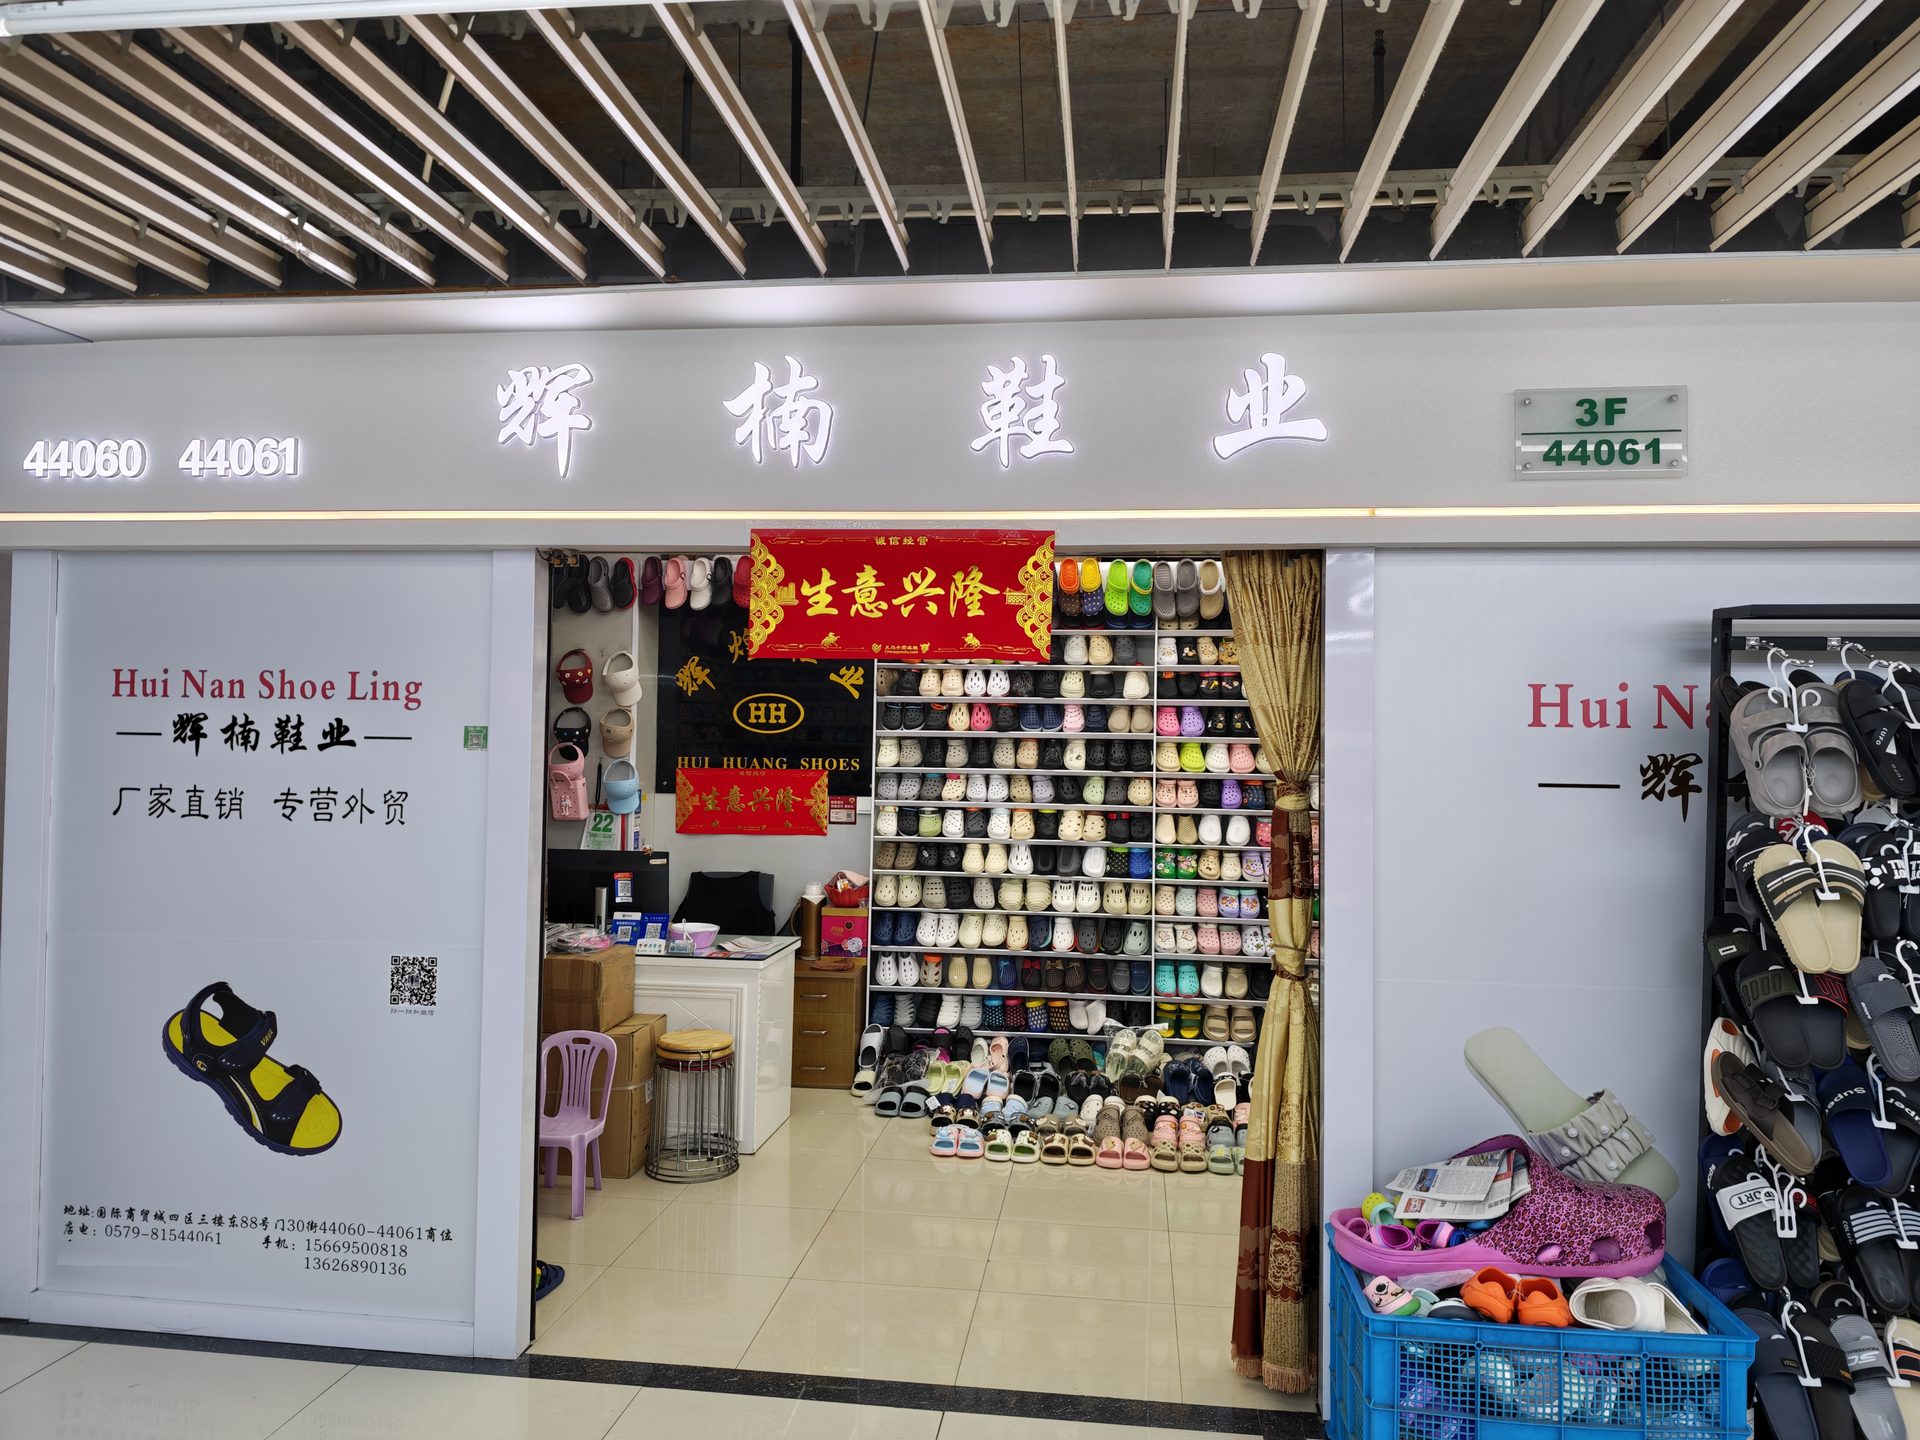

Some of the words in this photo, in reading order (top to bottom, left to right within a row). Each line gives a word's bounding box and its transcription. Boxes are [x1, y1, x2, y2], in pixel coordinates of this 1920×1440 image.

[497, 353, 1328, 479] 辉楠鞋业
[1575, 397, 1628, 427] 3F
[23, 439, 147, 479] 44060
[178, 437, 302, 477] 44061
[1542, 437, 1661, 467] 44061
[875, 536, 929, 546] 诚信经营
[800, 564, 1000, 619] 生意兴隆
[112, 668, 170, 698] Hui
[181, 669, 246, 699] Nan
[258, 669, 336, 700] Shoe
[347, 671, 423, 711] Ling
[748, 703, 787, 724] HH
[1527, 682, 1632, 729] Hui
[171, 712, 357, 757] 辉楠鞋业
[677, 757, 710, 769] HUI
[723, 757, 788, 770] HUANG
[800, 757, 860, 771] SHOES
[112, 783, 245, 820] 厂家直销
[273, 787, 409, 826] 专营外贸
[701, 785, 801, 812] 生意兴隆
[591, 813, 615, 833] 22
[303, 1256, 407, 1276] 13626890136
